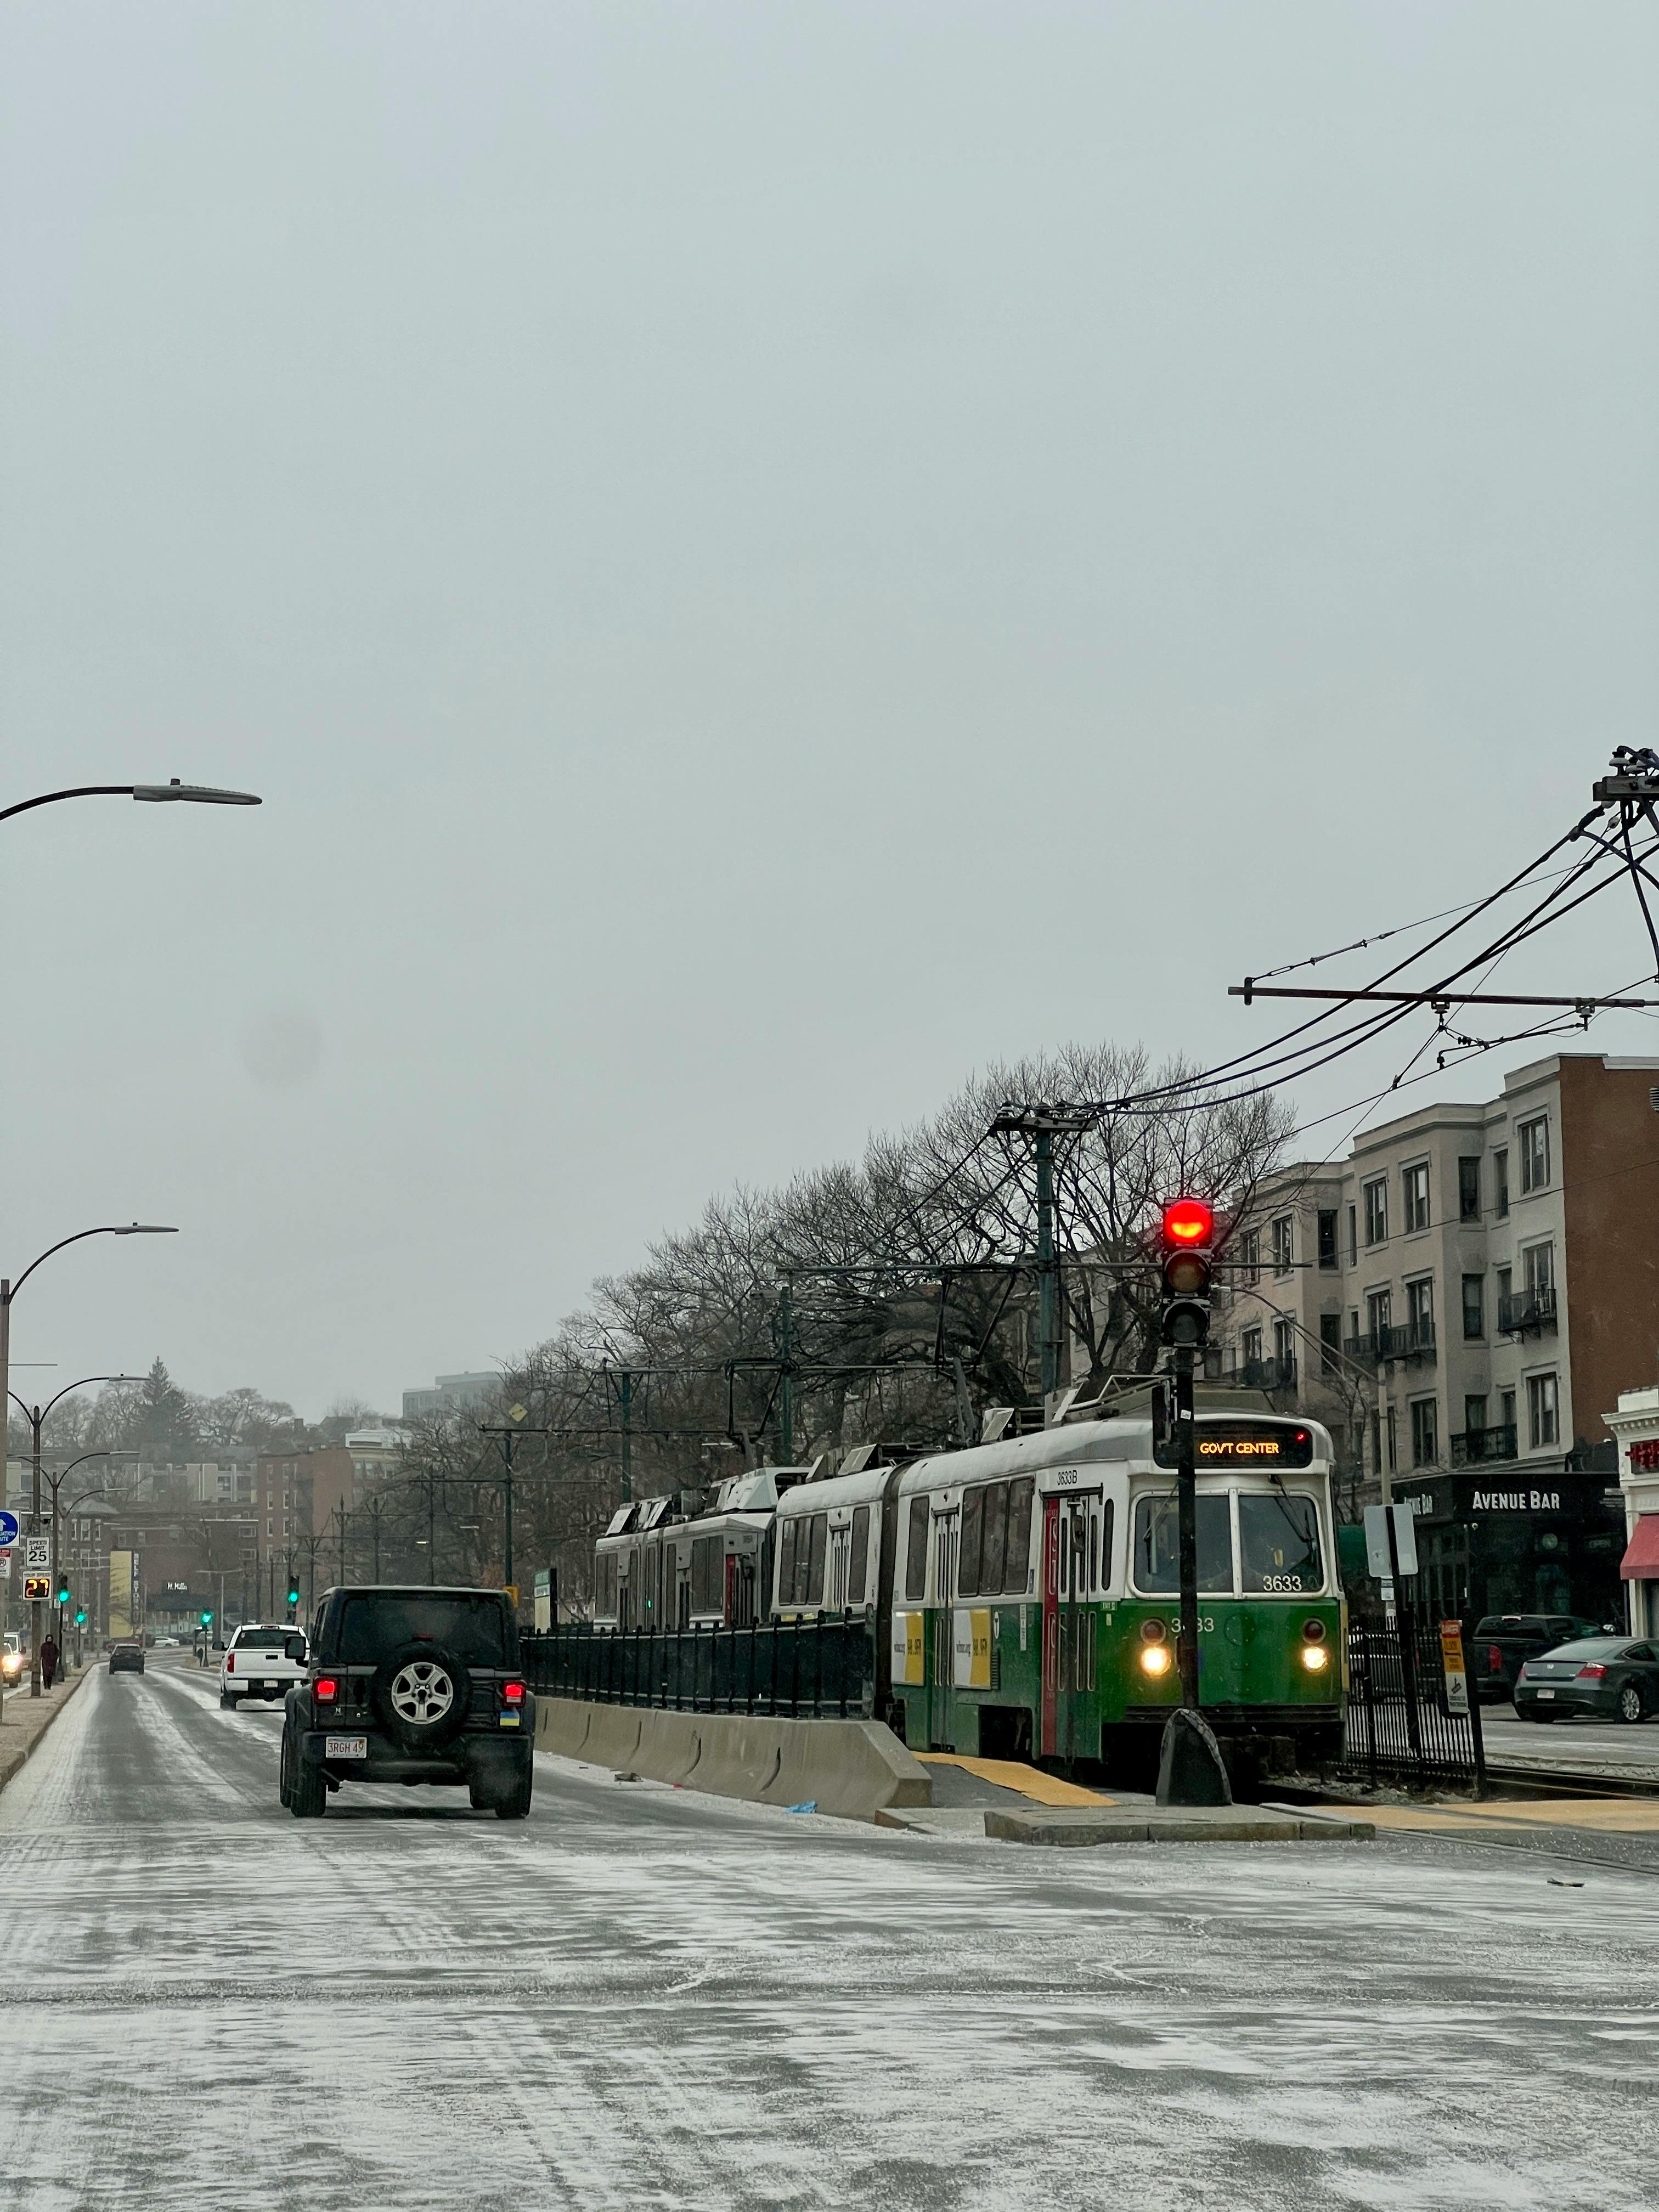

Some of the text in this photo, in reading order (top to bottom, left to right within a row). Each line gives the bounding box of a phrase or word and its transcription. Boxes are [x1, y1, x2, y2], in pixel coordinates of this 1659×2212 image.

[1200, 1443, 1279, 1454] GOV'T CENTER
[1057, 1470, 1077, 1486] 3633B
[1472, 1490, 1560, 1509] AVENUE BAR
[29, 1551, 47, 1561] 25
[26, 1579, 48, 1597] 27
[1263, 1575, 1302, 1591] 3633
[1171, 1617, 1215, 1633] 333
[328, 1742, 364, 1753] 3RGH 49
